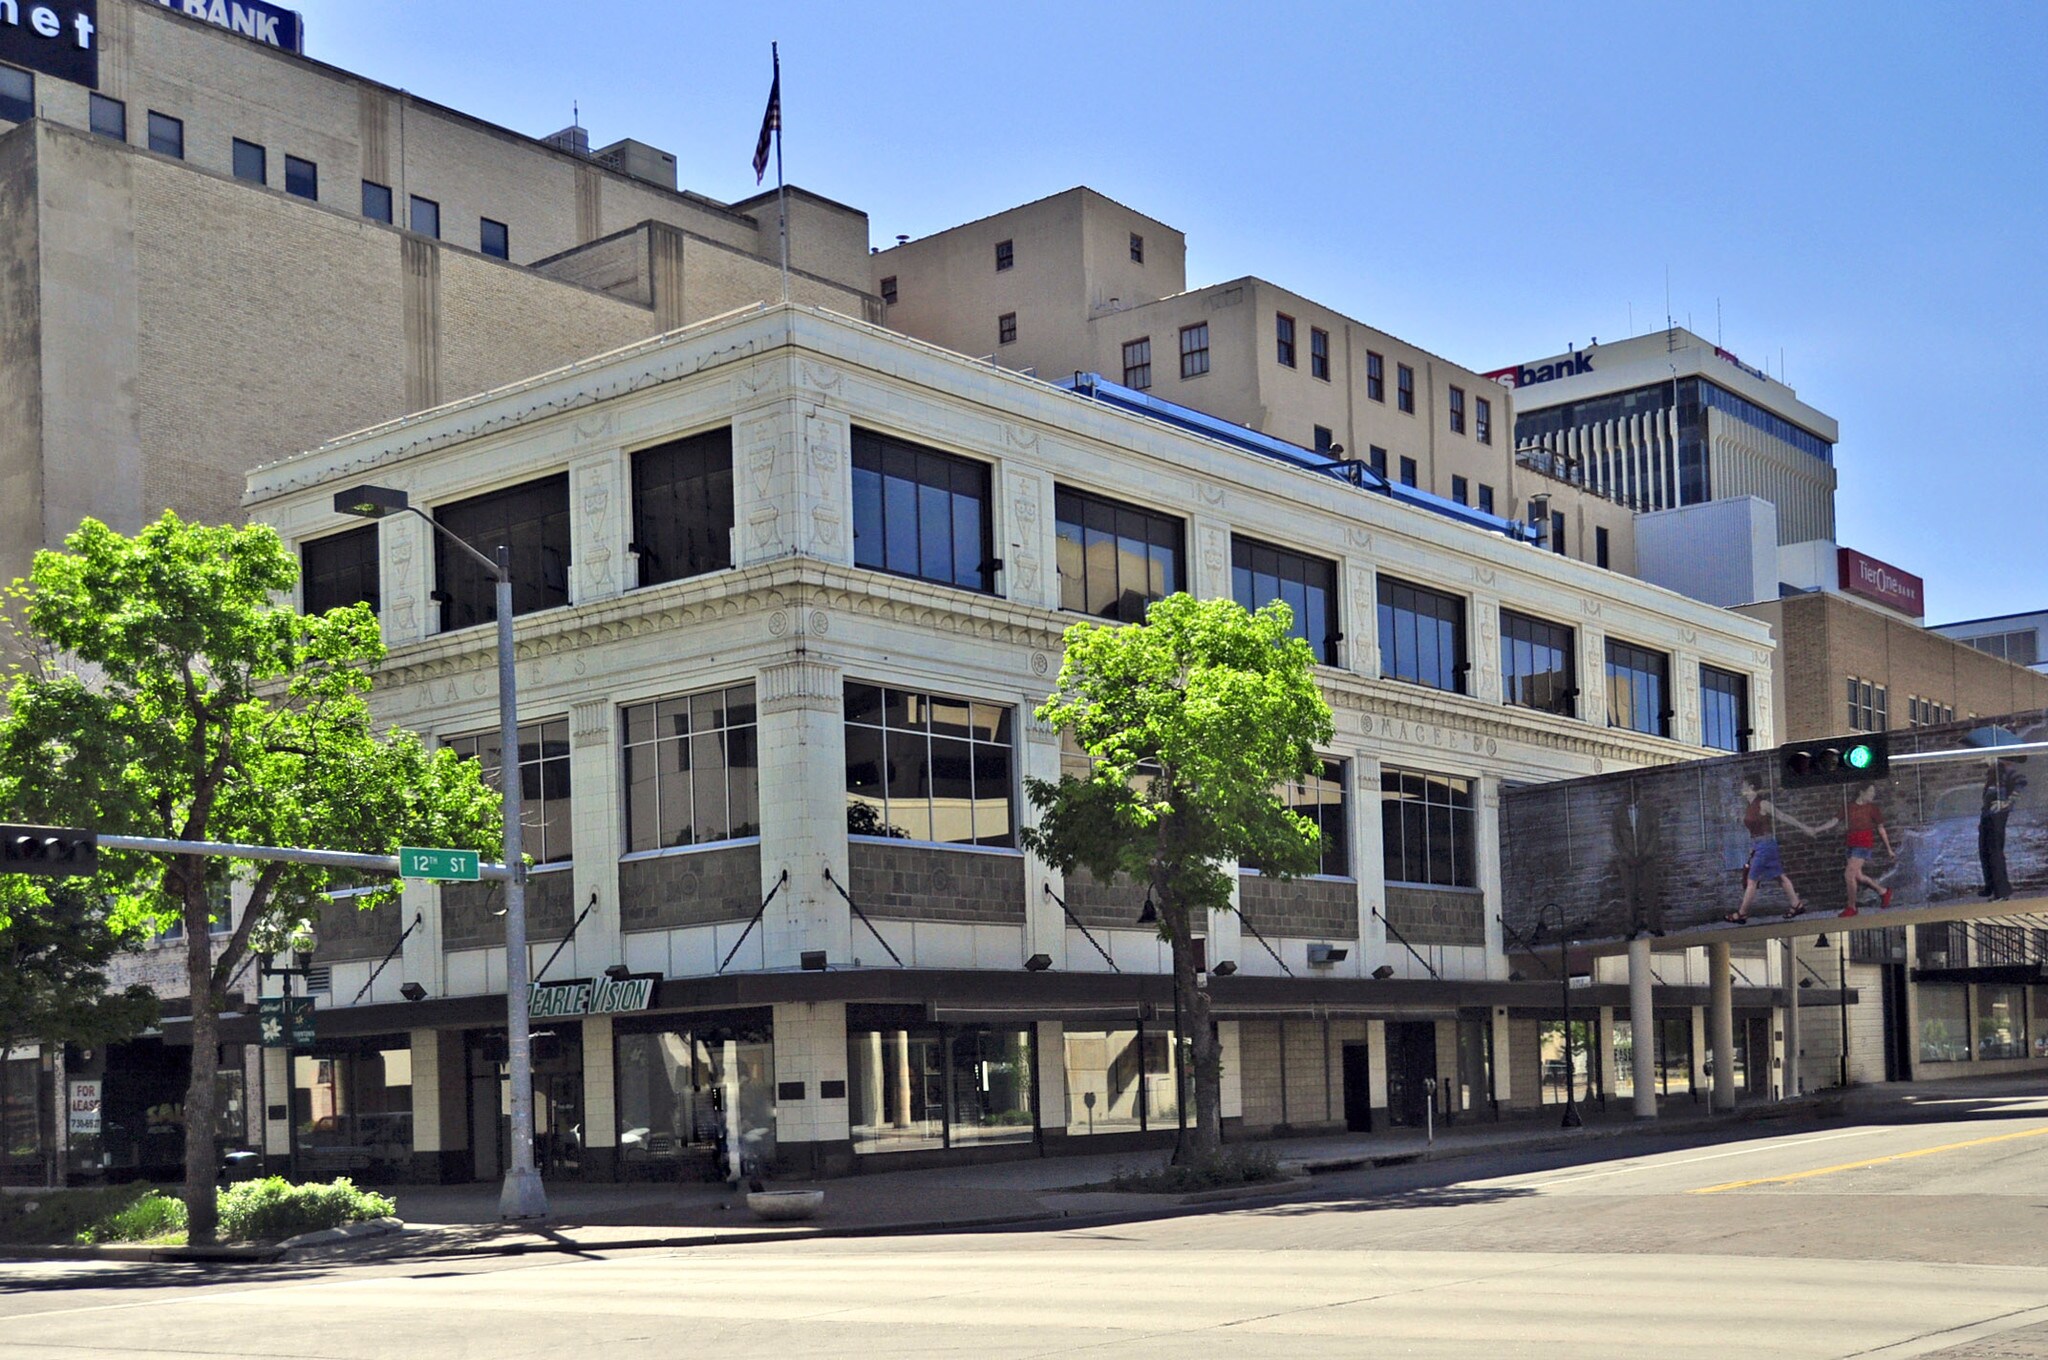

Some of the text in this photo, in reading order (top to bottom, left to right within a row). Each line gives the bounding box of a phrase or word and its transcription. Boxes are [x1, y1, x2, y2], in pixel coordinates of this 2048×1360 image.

[183, 0, 280, 47] BANK
[1858, 560, 1898, 593] TierOne
[415, 653, 586, 708] MAGE'S
[413, 855, 466, 873] 12TH ST
[588, 976, 655, 1015] VISION
[77, 1085, 95, 1097] FOR
